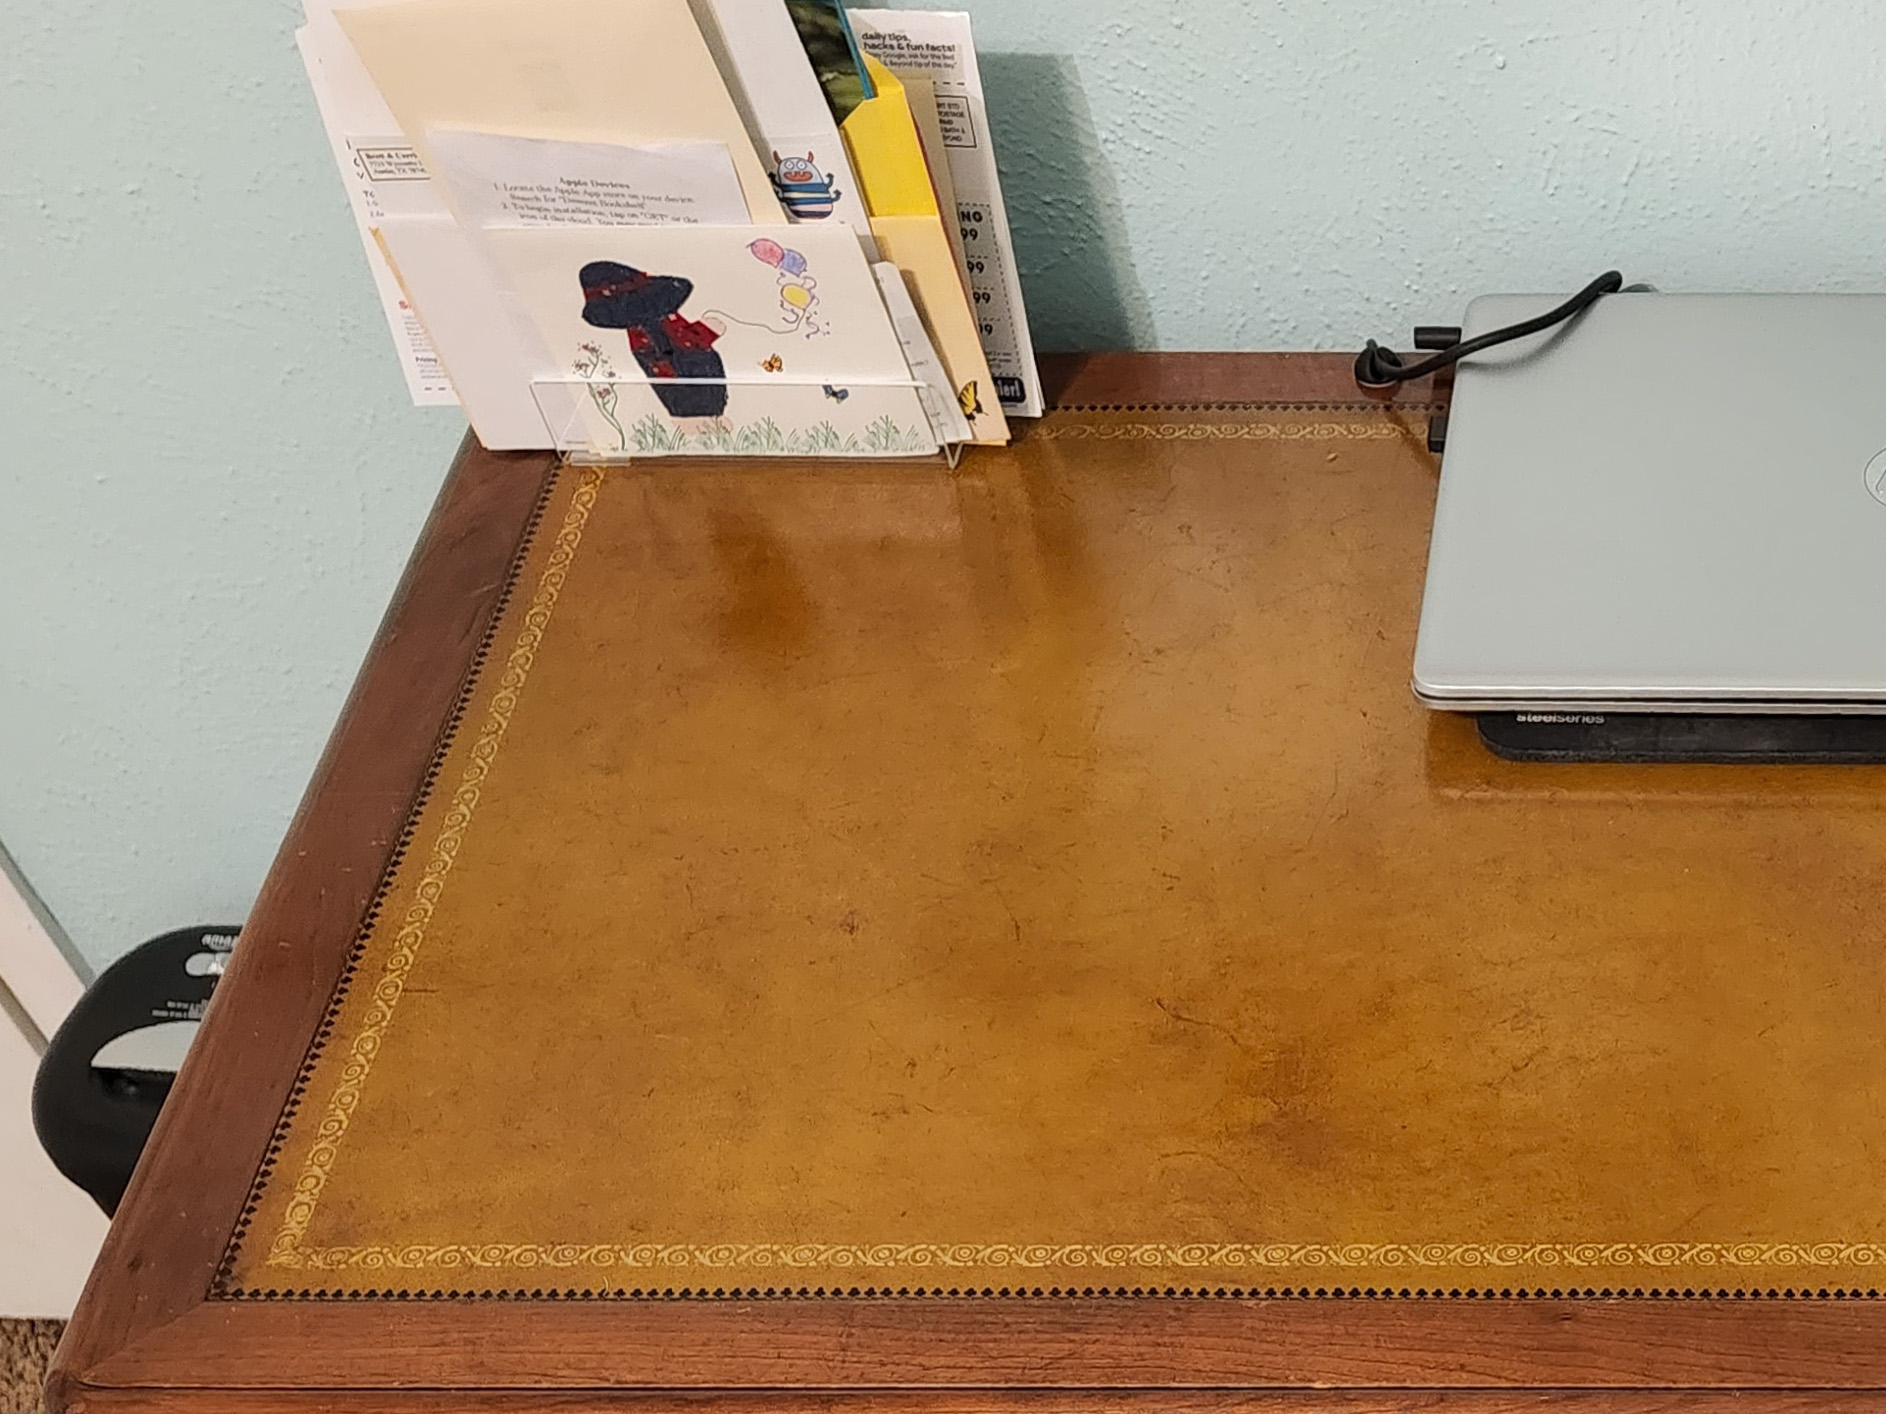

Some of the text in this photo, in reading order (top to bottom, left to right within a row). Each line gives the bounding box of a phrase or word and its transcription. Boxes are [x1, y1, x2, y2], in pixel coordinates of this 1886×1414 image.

[862, 32, 911, 44] daily tips,
[906, 43, 924, 51] fun
[925, 43, 956, 51] facts!
